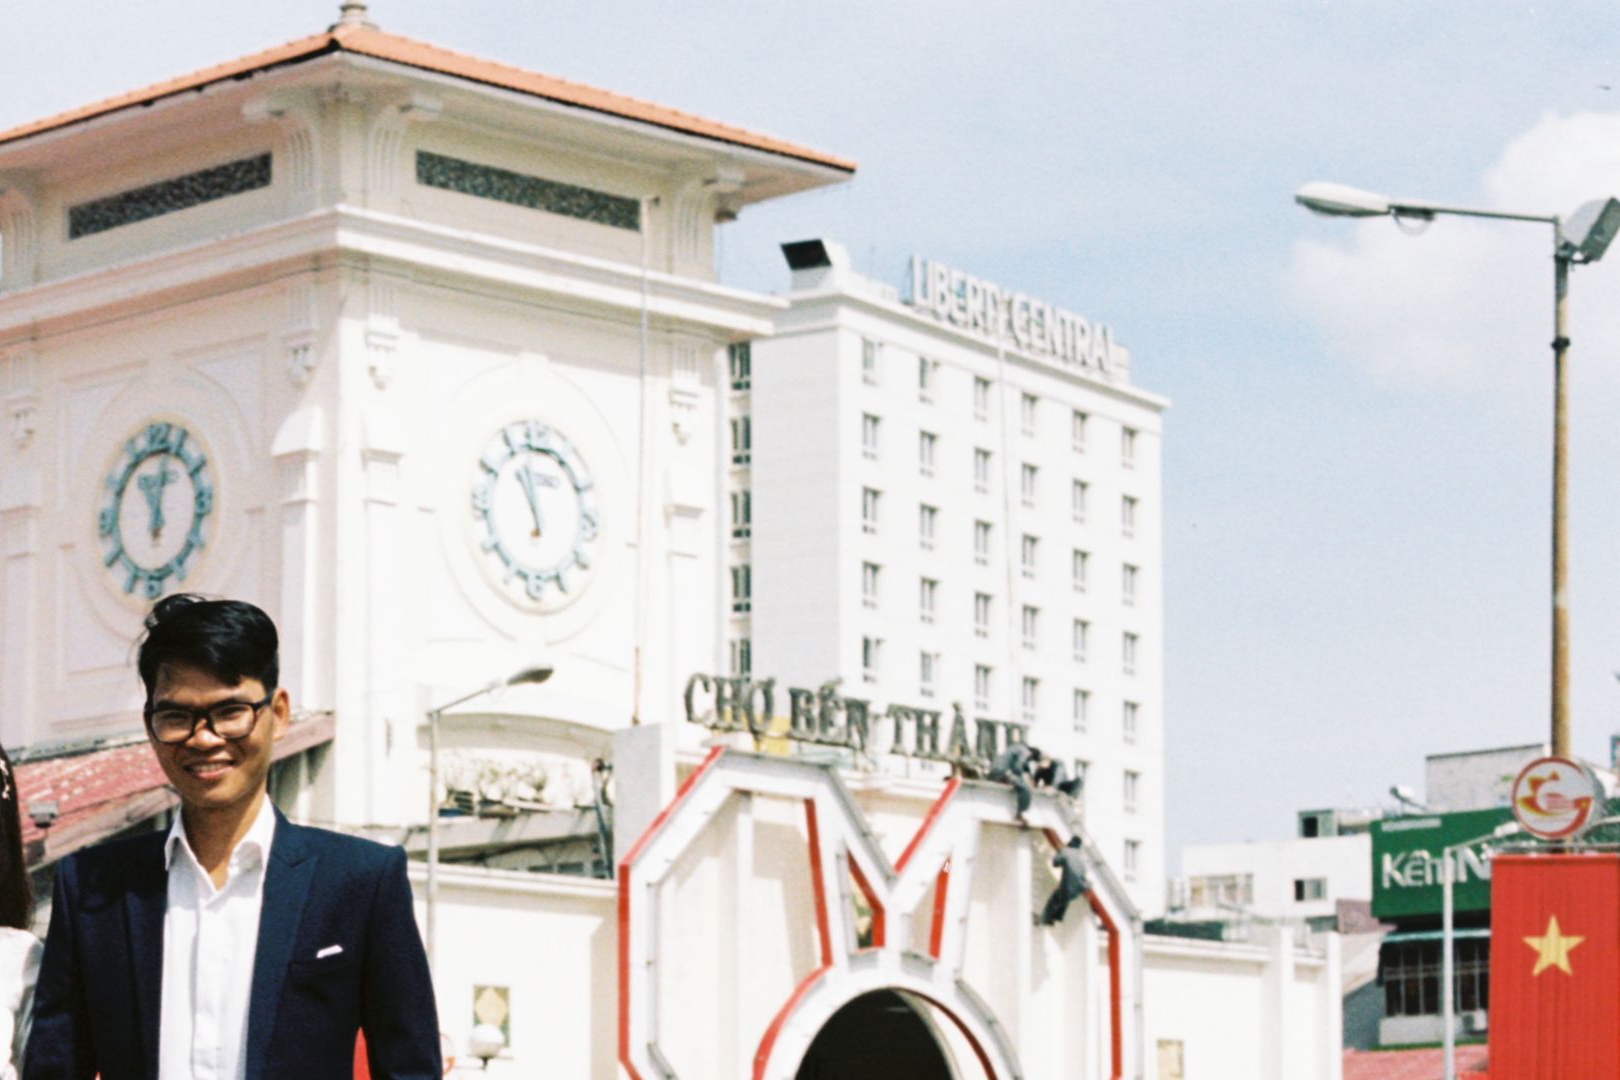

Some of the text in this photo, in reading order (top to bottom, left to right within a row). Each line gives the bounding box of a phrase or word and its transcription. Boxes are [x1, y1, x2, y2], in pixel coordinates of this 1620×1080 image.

[683, 672, 1030, 768] CHỢ BẾN THÀNH
